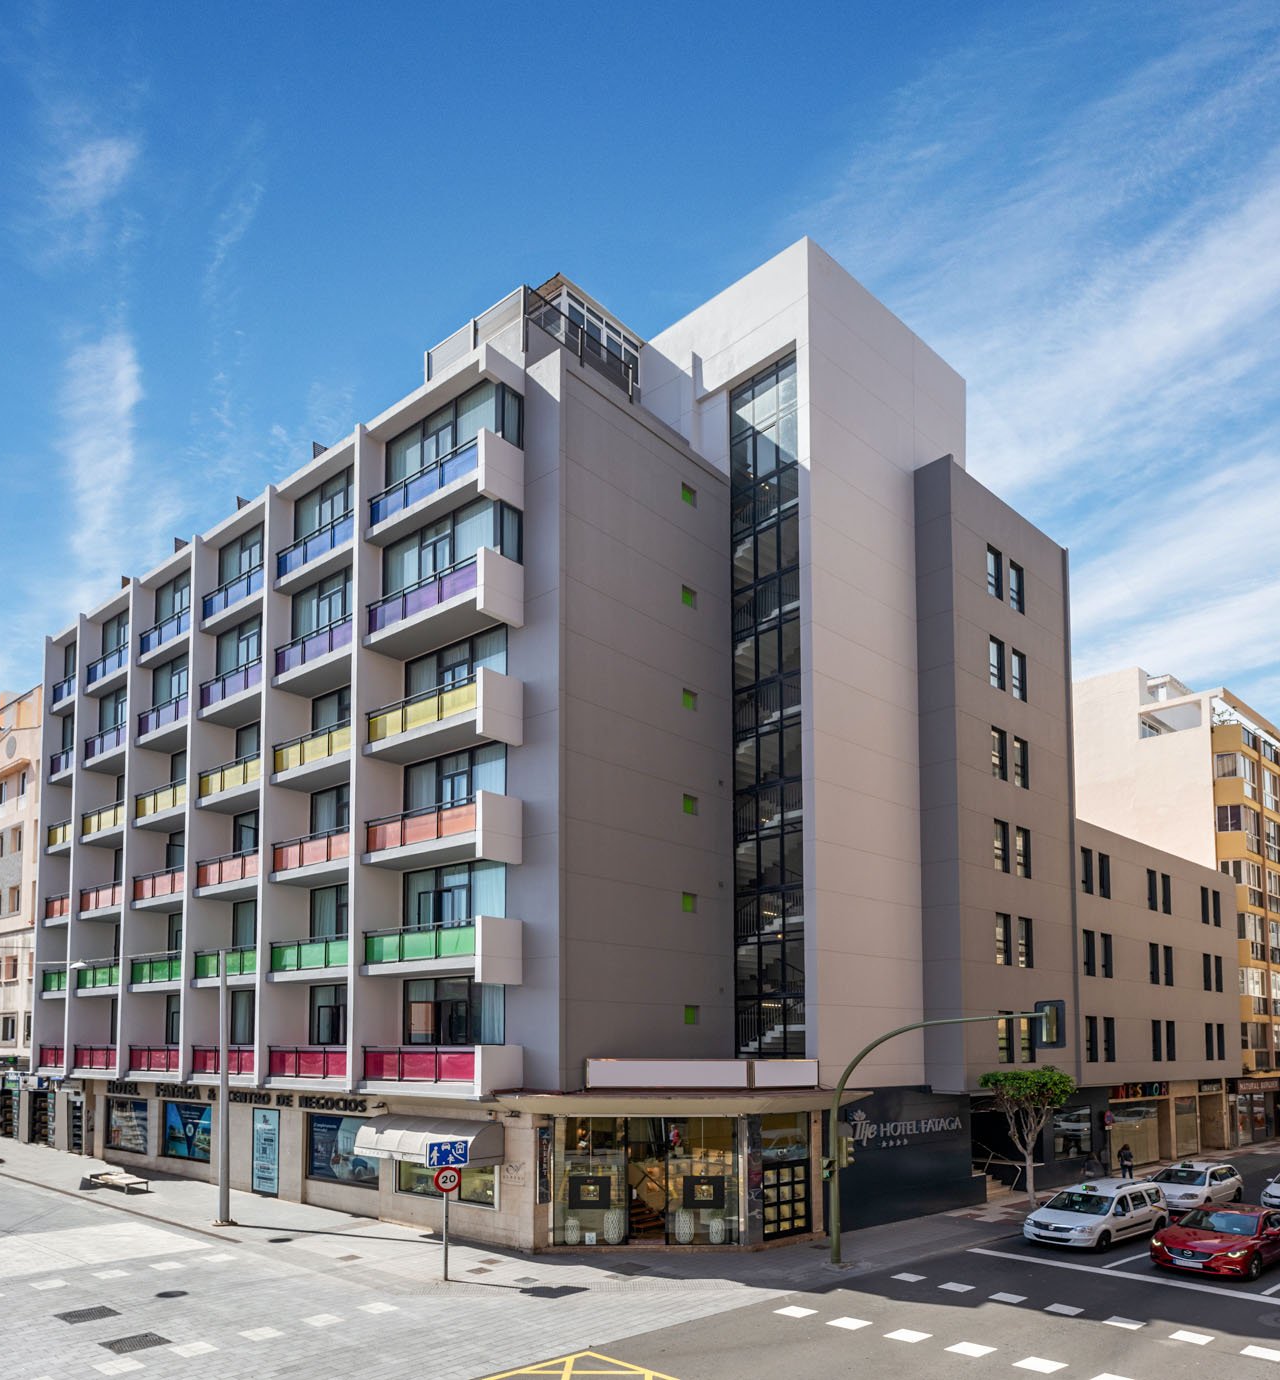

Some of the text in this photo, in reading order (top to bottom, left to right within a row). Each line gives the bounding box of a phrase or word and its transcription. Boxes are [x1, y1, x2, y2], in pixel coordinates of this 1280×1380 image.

[107, 1081, 367, 1112] HOTEL FATAGA & CENTRO DE NEGOCIOS
[880, 1121, 919, 1137] HOTEL
[921, 1116, 962, 1133] FATAGA
[441, 1174, 456, 1184] 20
